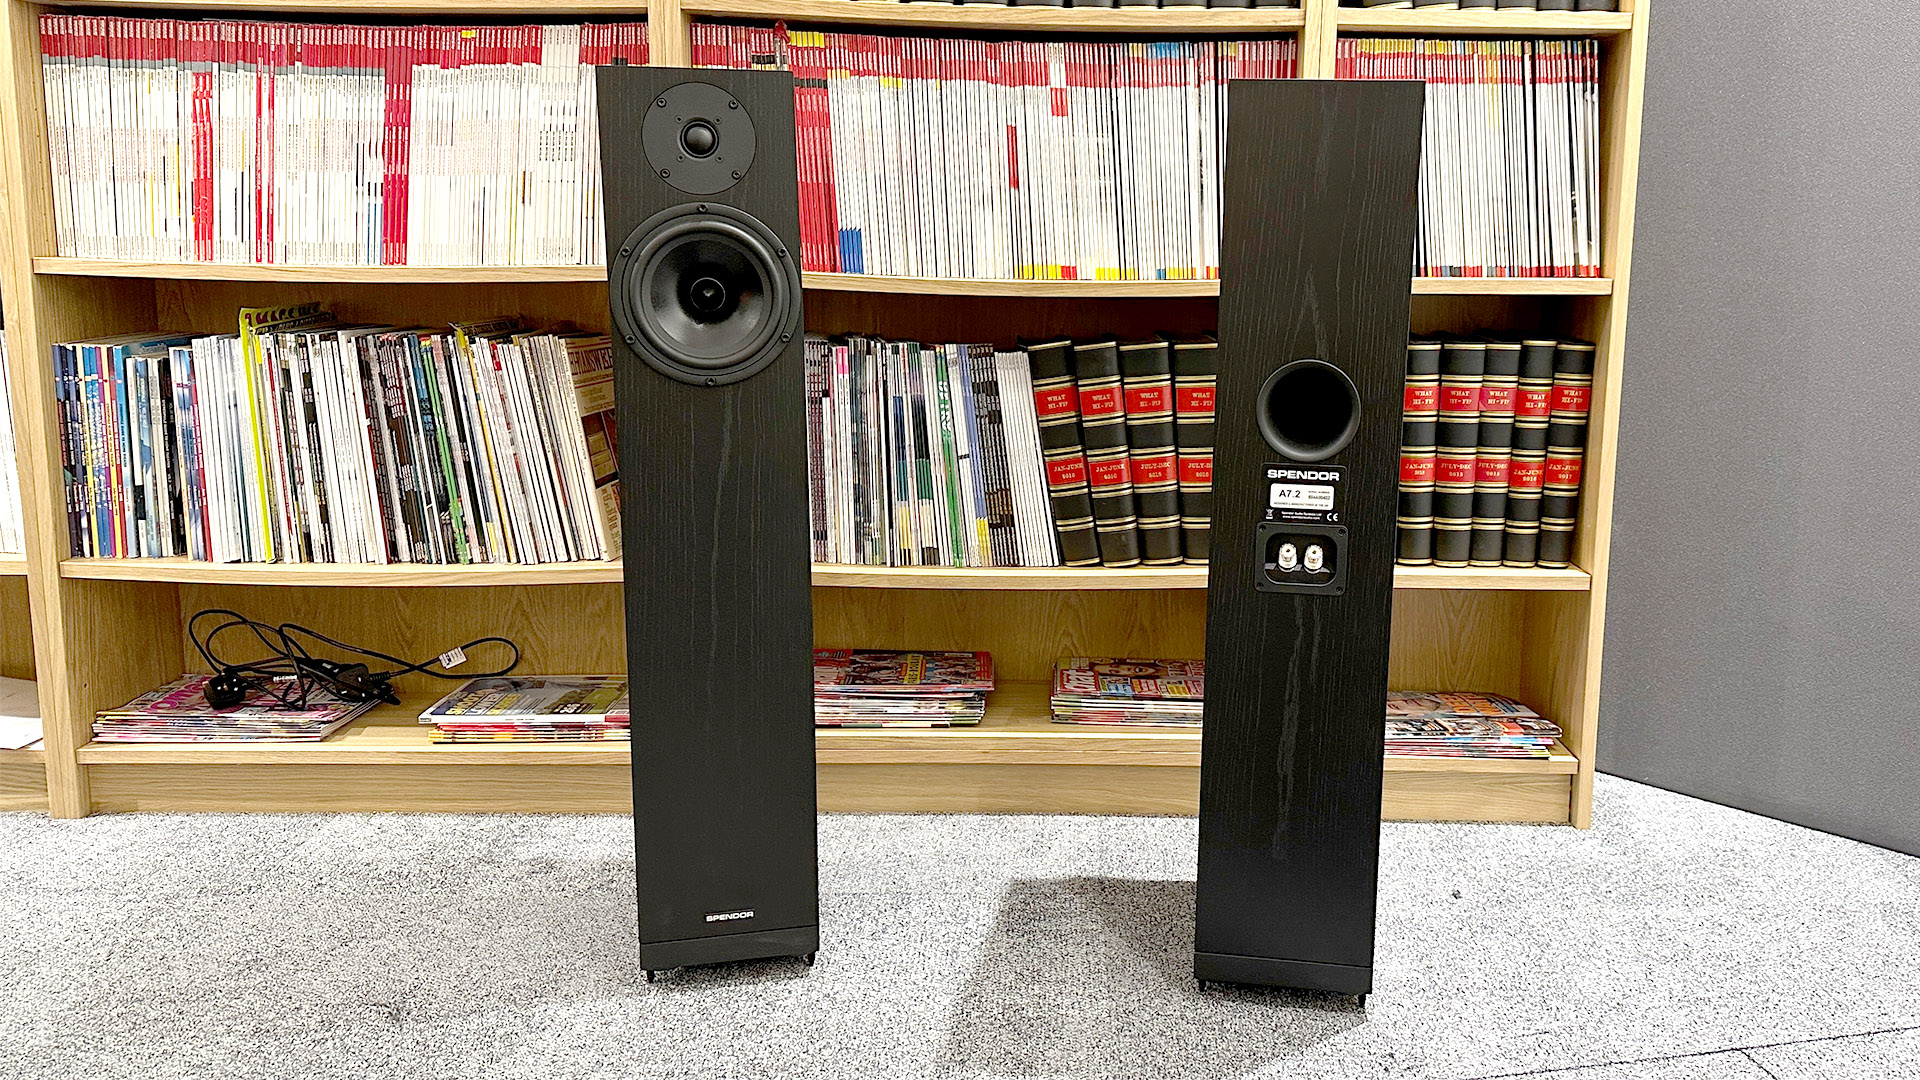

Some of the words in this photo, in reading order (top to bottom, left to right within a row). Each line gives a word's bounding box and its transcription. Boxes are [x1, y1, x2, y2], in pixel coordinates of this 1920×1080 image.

[1267, 469, 1340, 482] SPENDOR
[1279, 490, 1301, 498] A7.2
[706, 911, 754, 922] SPENDOR
